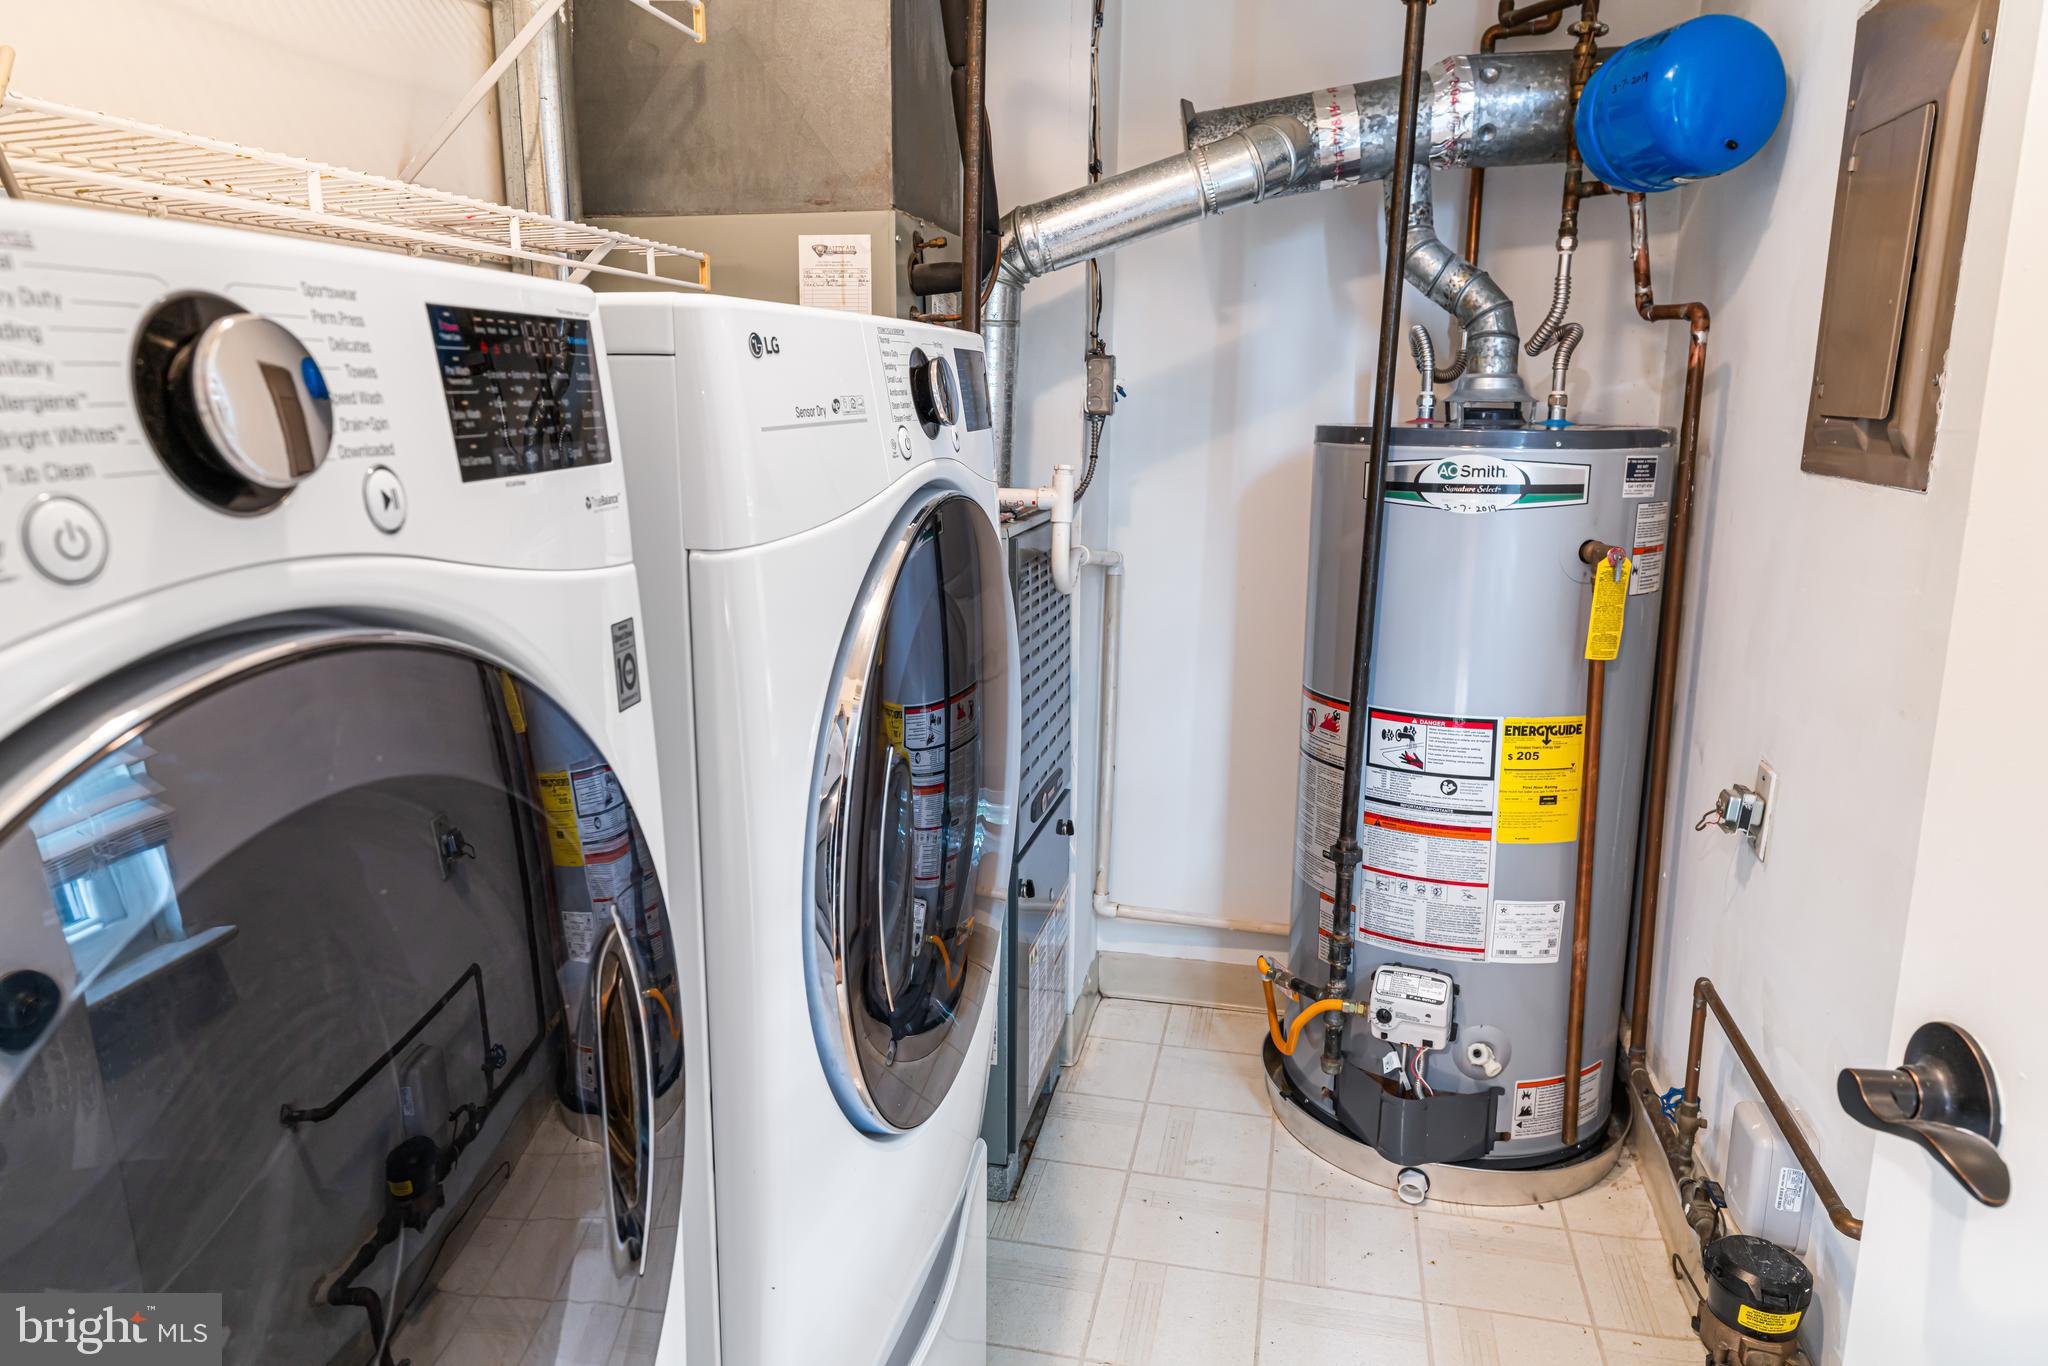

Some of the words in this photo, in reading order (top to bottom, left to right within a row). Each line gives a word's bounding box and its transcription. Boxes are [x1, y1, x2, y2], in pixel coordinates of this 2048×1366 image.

[763, 336, 780, 354] LG
[795, 406, 816, 418] Sensor
[816, 405, 827, 419] Dry
[43, 461, 95, 482] Clean
[1460, 465, 1505, 478] Smith
[1442, 485, 1476, 493] Signature
[1420, 719, 1446, 727] DANGER
[1504, 724, 1583, 738] ENERGYGUIDE
[1516, 751, 1539, 760] 205
